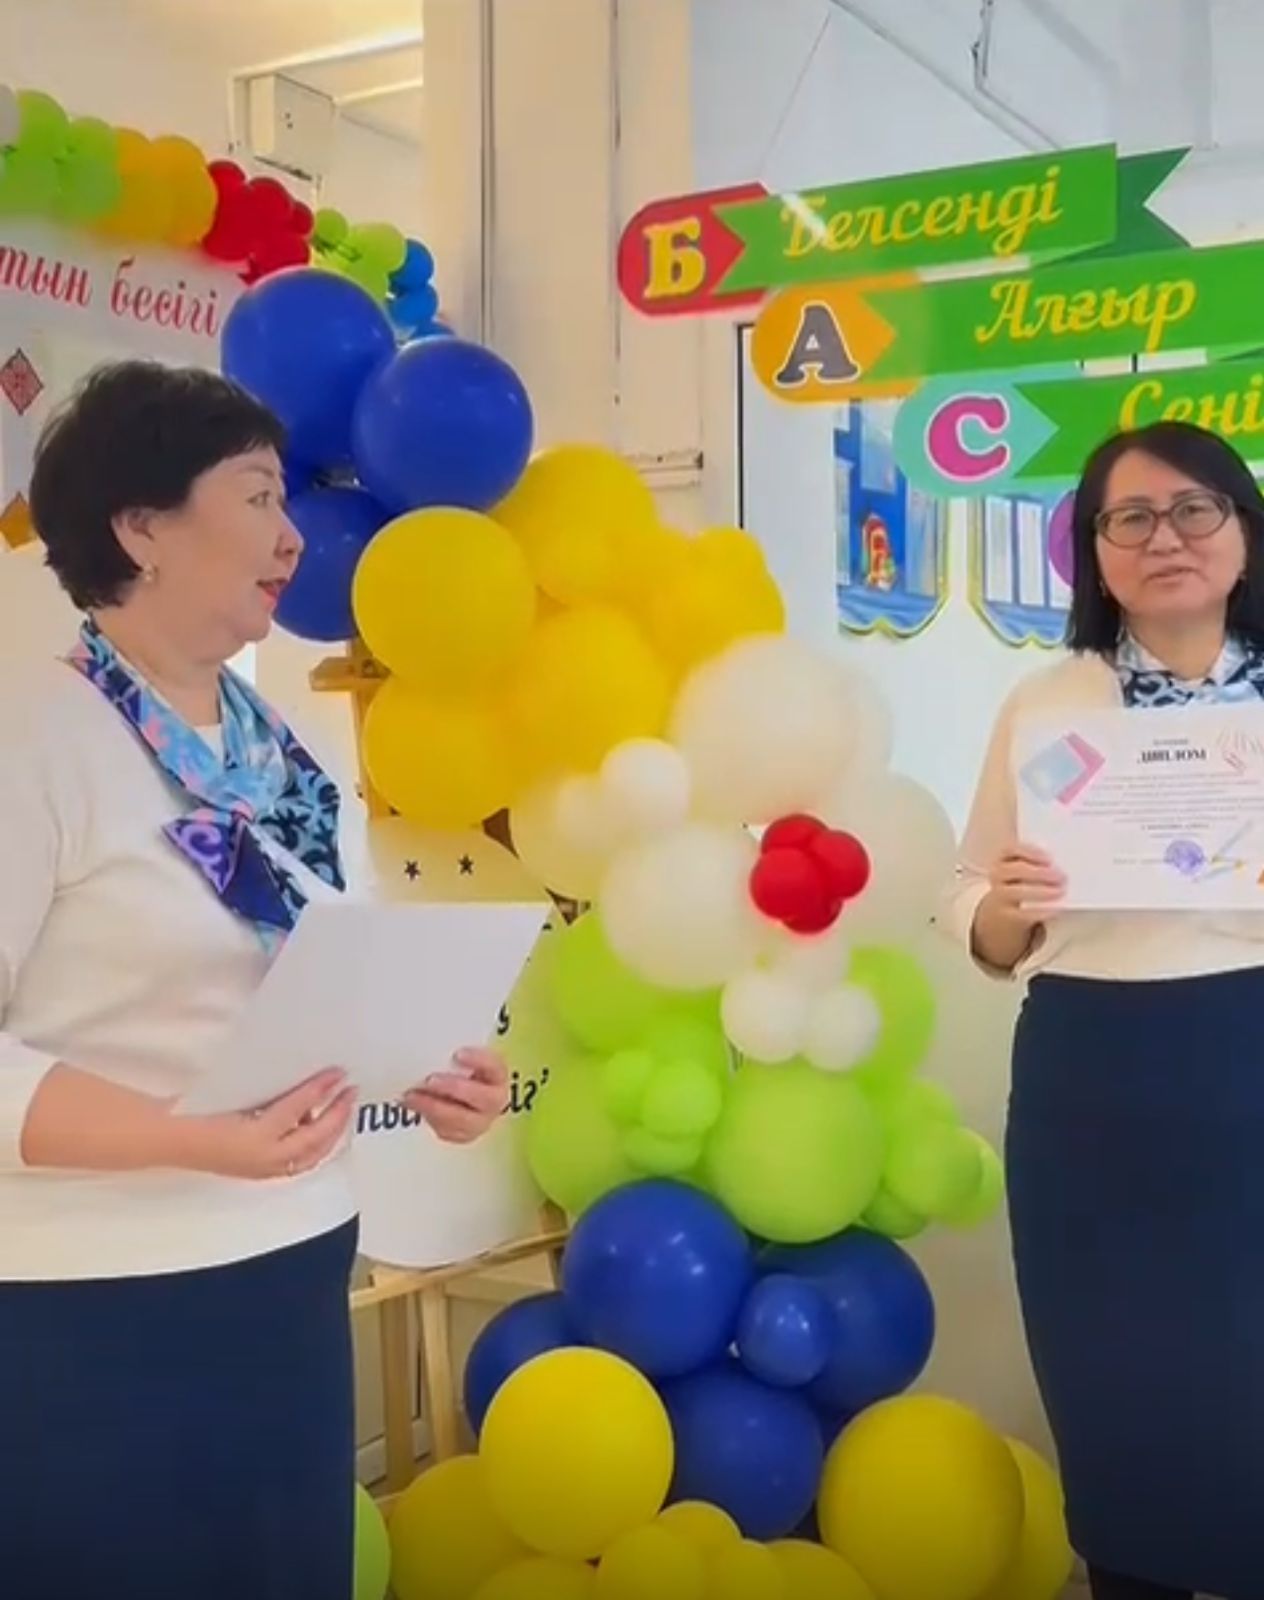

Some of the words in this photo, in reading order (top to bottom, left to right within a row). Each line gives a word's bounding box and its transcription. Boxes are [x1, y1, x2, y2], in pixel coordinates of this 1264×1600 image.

[643, 216, 707, 299] Б
[780, 166, 1062, 258] Белсенді
[111, 256, 219, 338] бесігі
[774, 301, 860, 388] А
[974, 278, 1196, 351] Алғыр
[923, 391, 1010, 483] С
